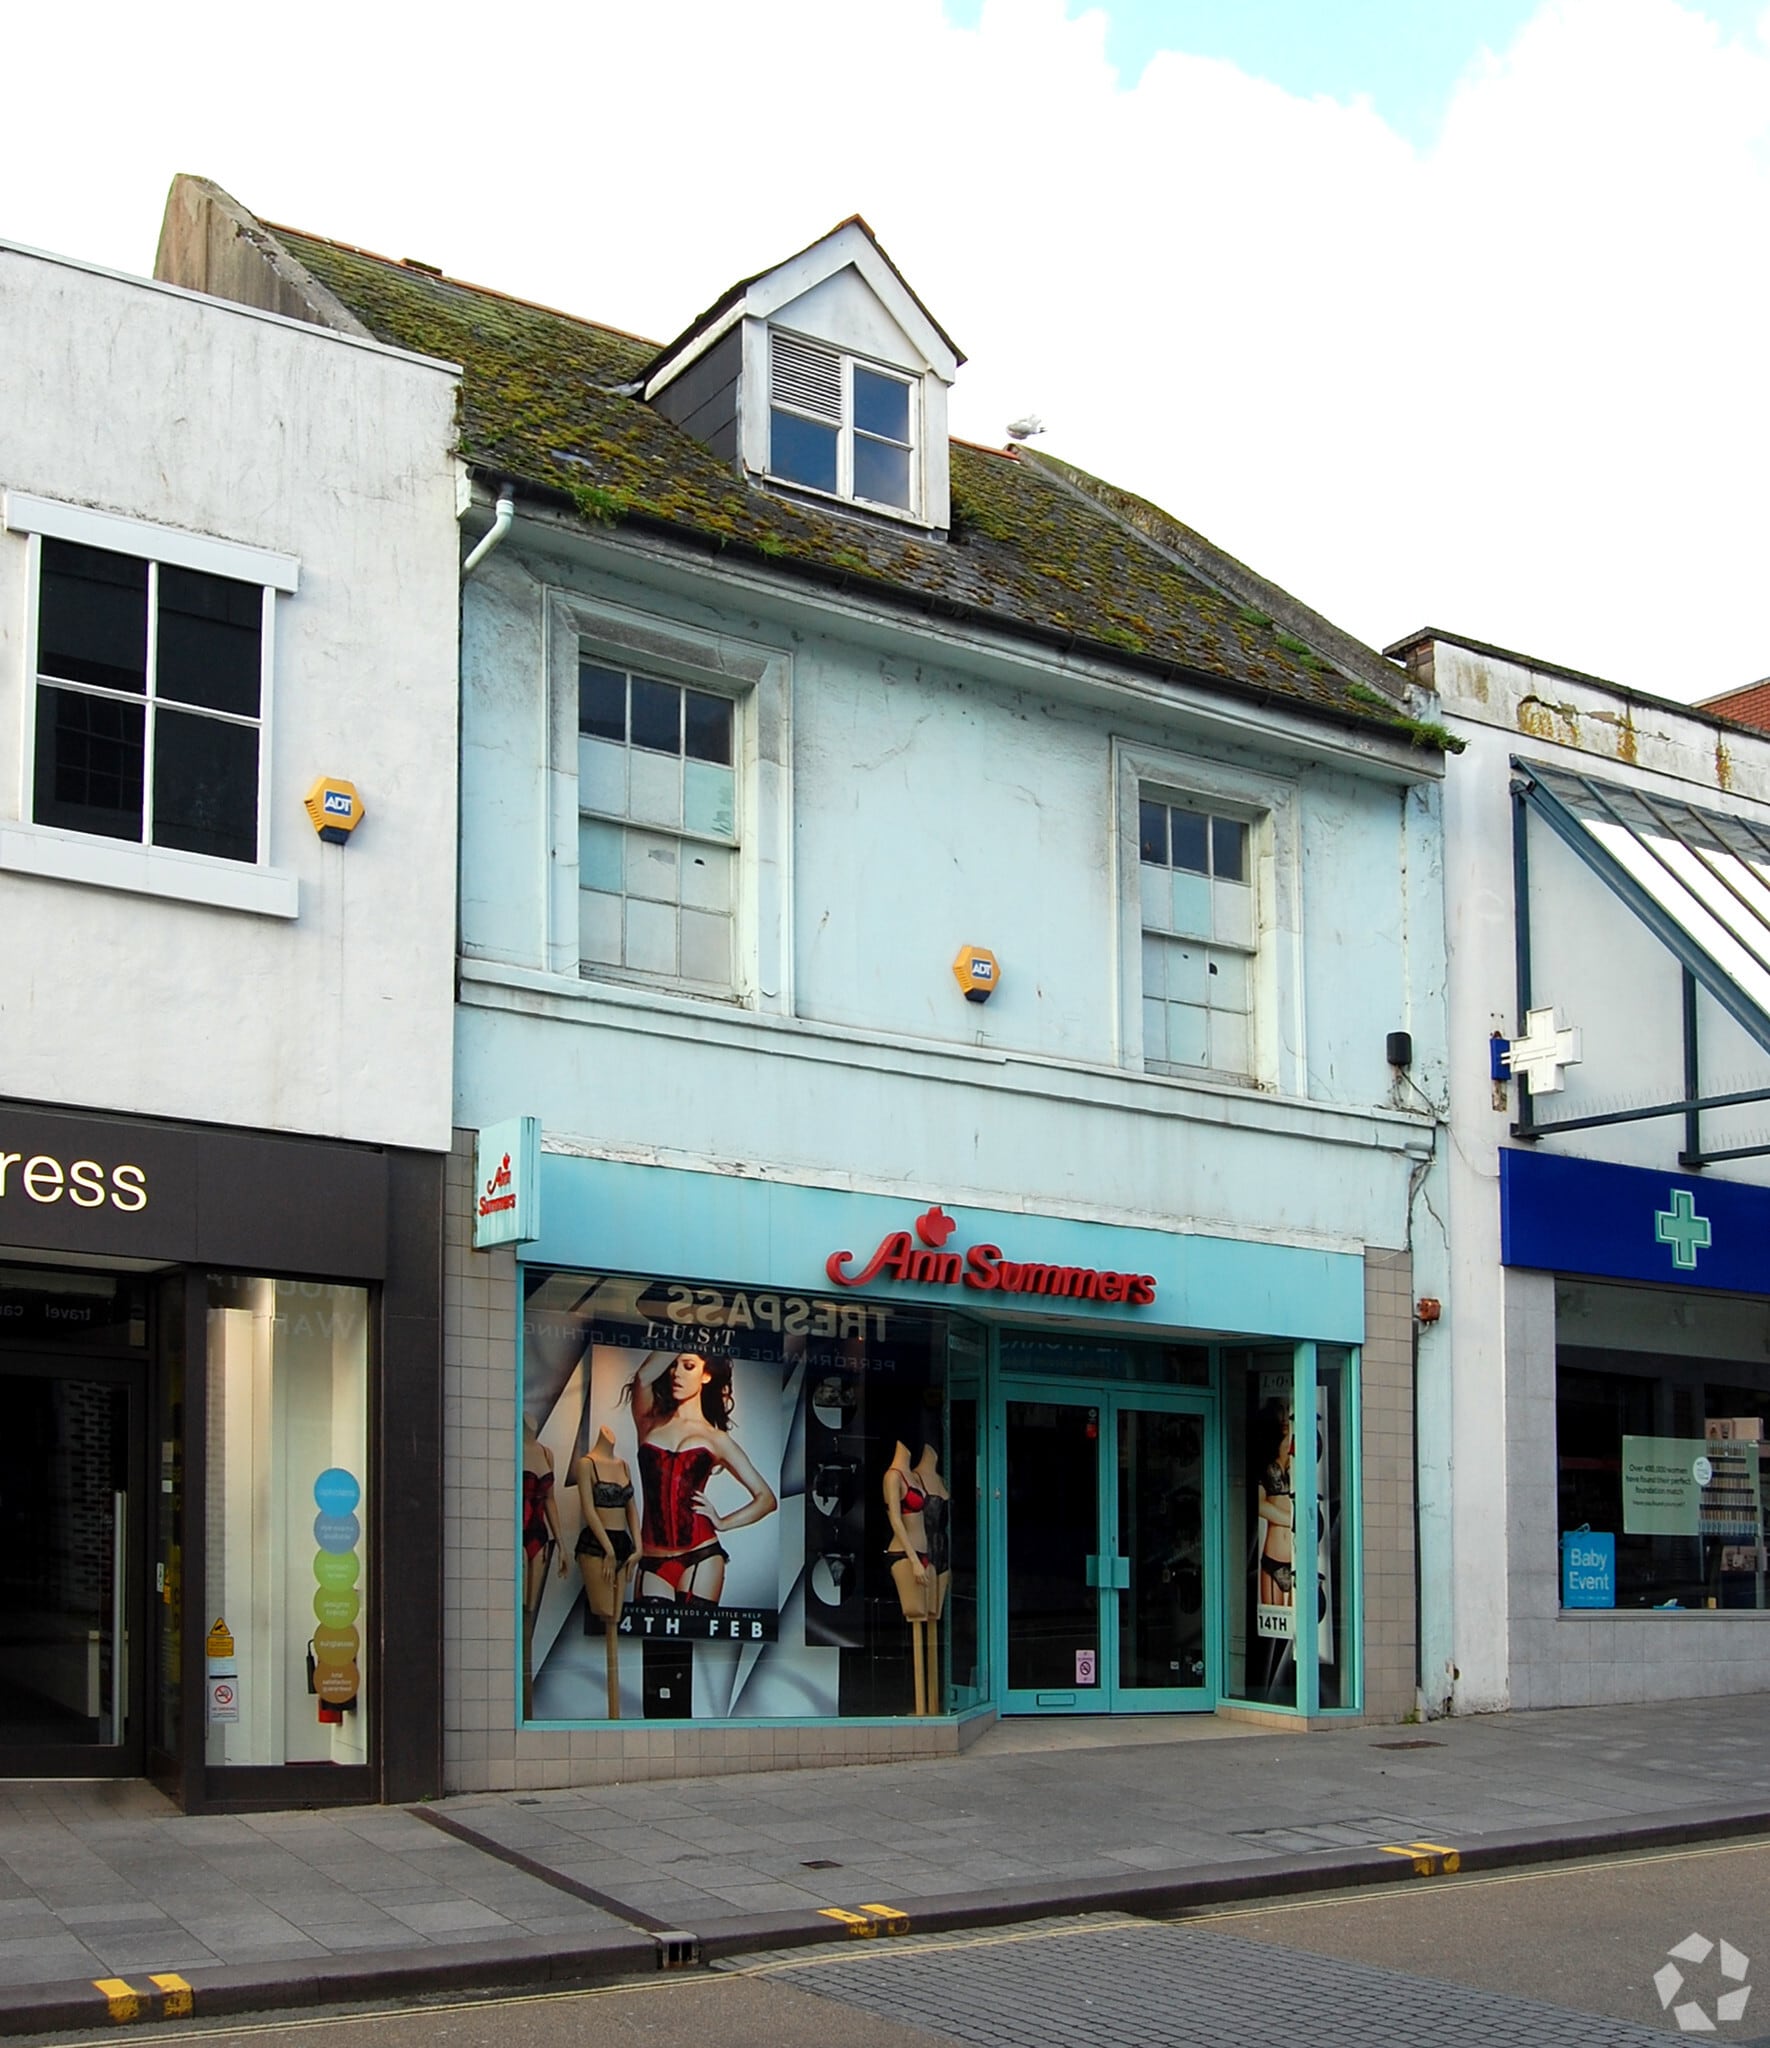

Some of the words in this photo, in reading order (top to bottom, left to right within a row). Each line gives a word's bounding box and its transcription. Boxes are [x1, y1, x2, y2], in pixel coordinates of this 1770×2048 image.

[325, 796, 352, 812] ADT
[972, 963, 992, 975] ADT
[0, 1152, 147, 1211] ress
[487, 1166, 511, 1195] Ann
[479, 1193, 517, 1216] Summers
[826, 1231, 963, 1287] Ann
[963, 1244, 1156, 1305] Summers
[1628, 1464, 1644, 1472] Over
[1571, 1548, 1607, 1571] Baby
[1569, 1571, 1609, 1590] Event
[650, 1607, 669, 1615] LUST
[673, 1608, 700, 1617] NEEDS
[709, 1619, 763, 1638] FEB
[1259, 1615, 1287, 1632] 14TH
